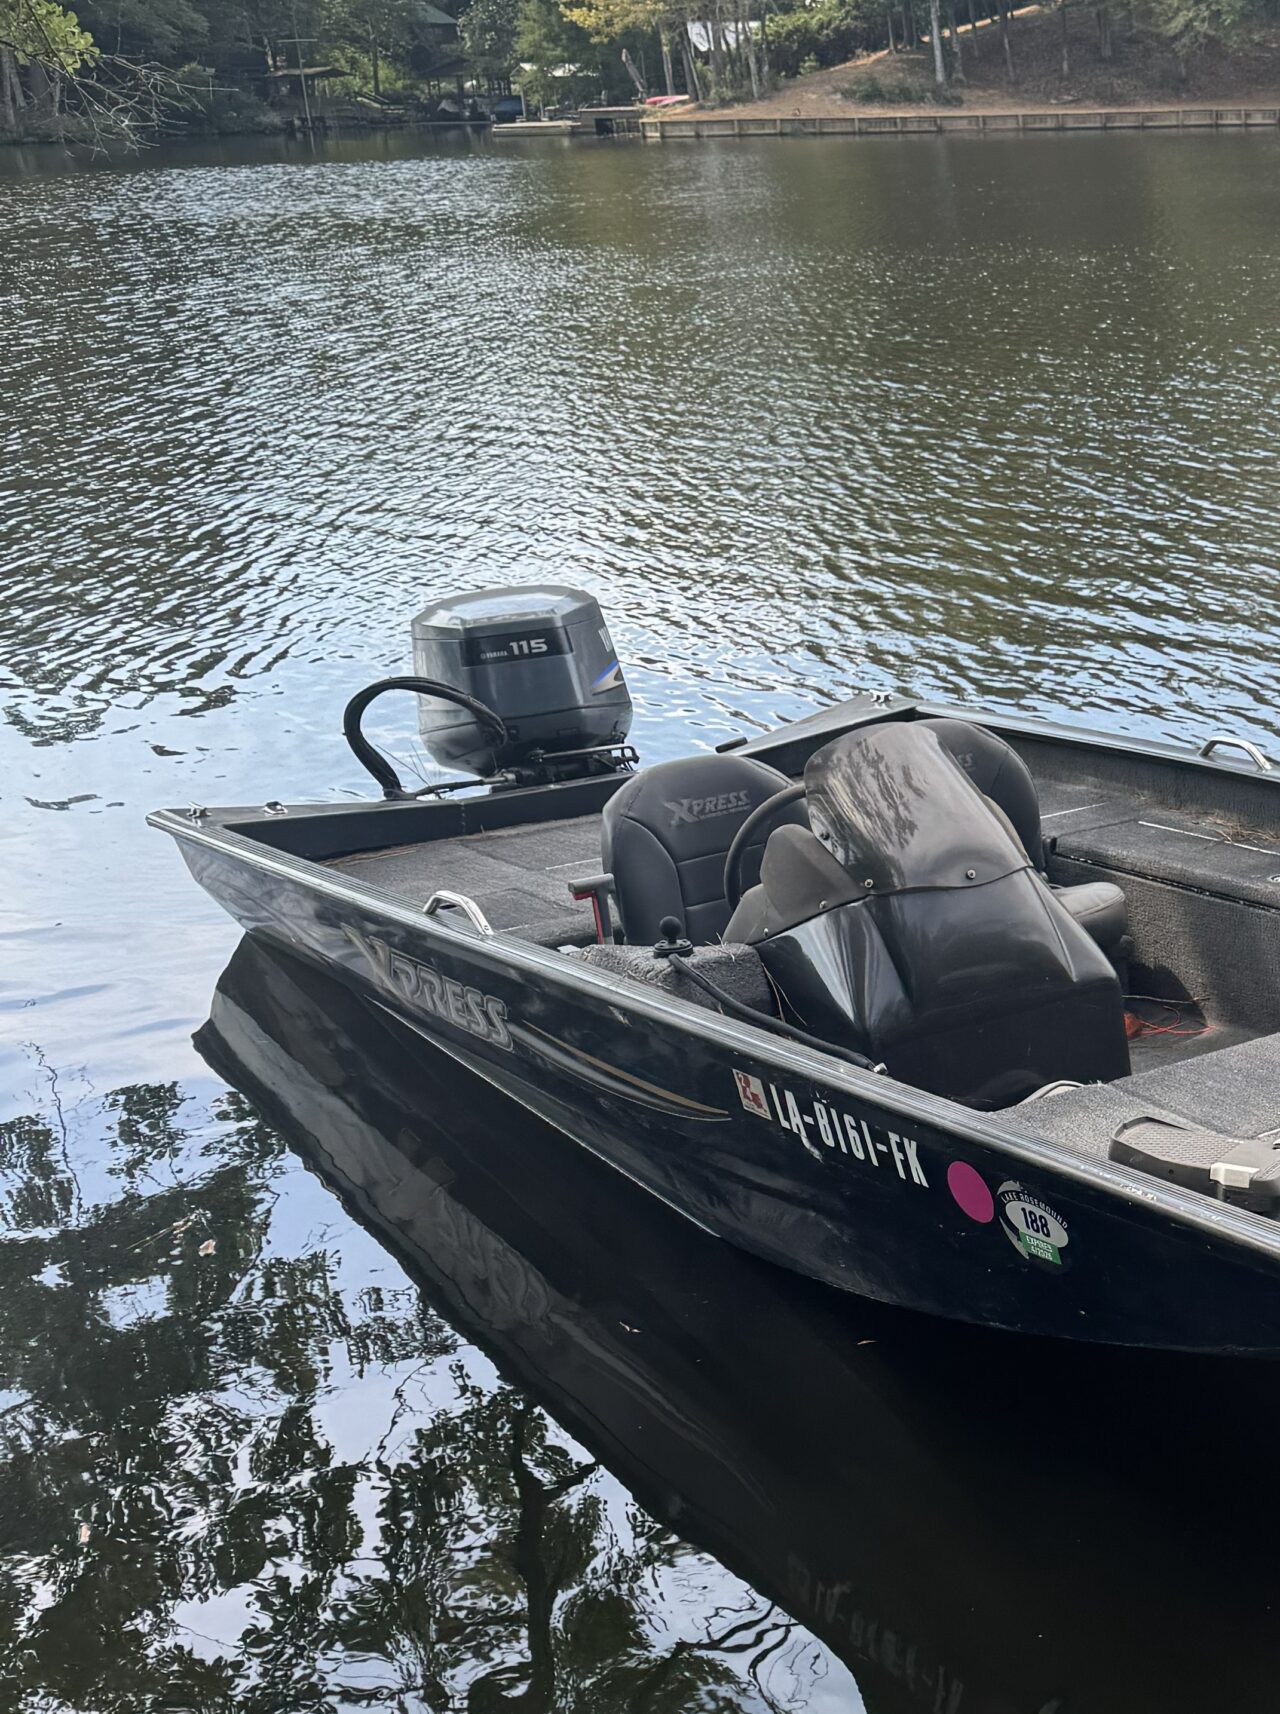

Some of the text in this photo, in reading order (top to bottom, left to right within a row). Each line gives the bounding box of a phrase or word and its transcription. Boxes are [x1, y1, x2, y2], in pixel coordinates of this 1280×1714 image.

[509, 638, 548, 656] 115
[662, 790, 751, 825] XPRESS
[341, 922, 514, 1052] XPRESS
[769, 1083, 930, 1188] LA-8161-FK
[1001, 1192, 1068, 1229] LAKE ROSEMOUND
[1020, 1207, 1051, 1238] 188
